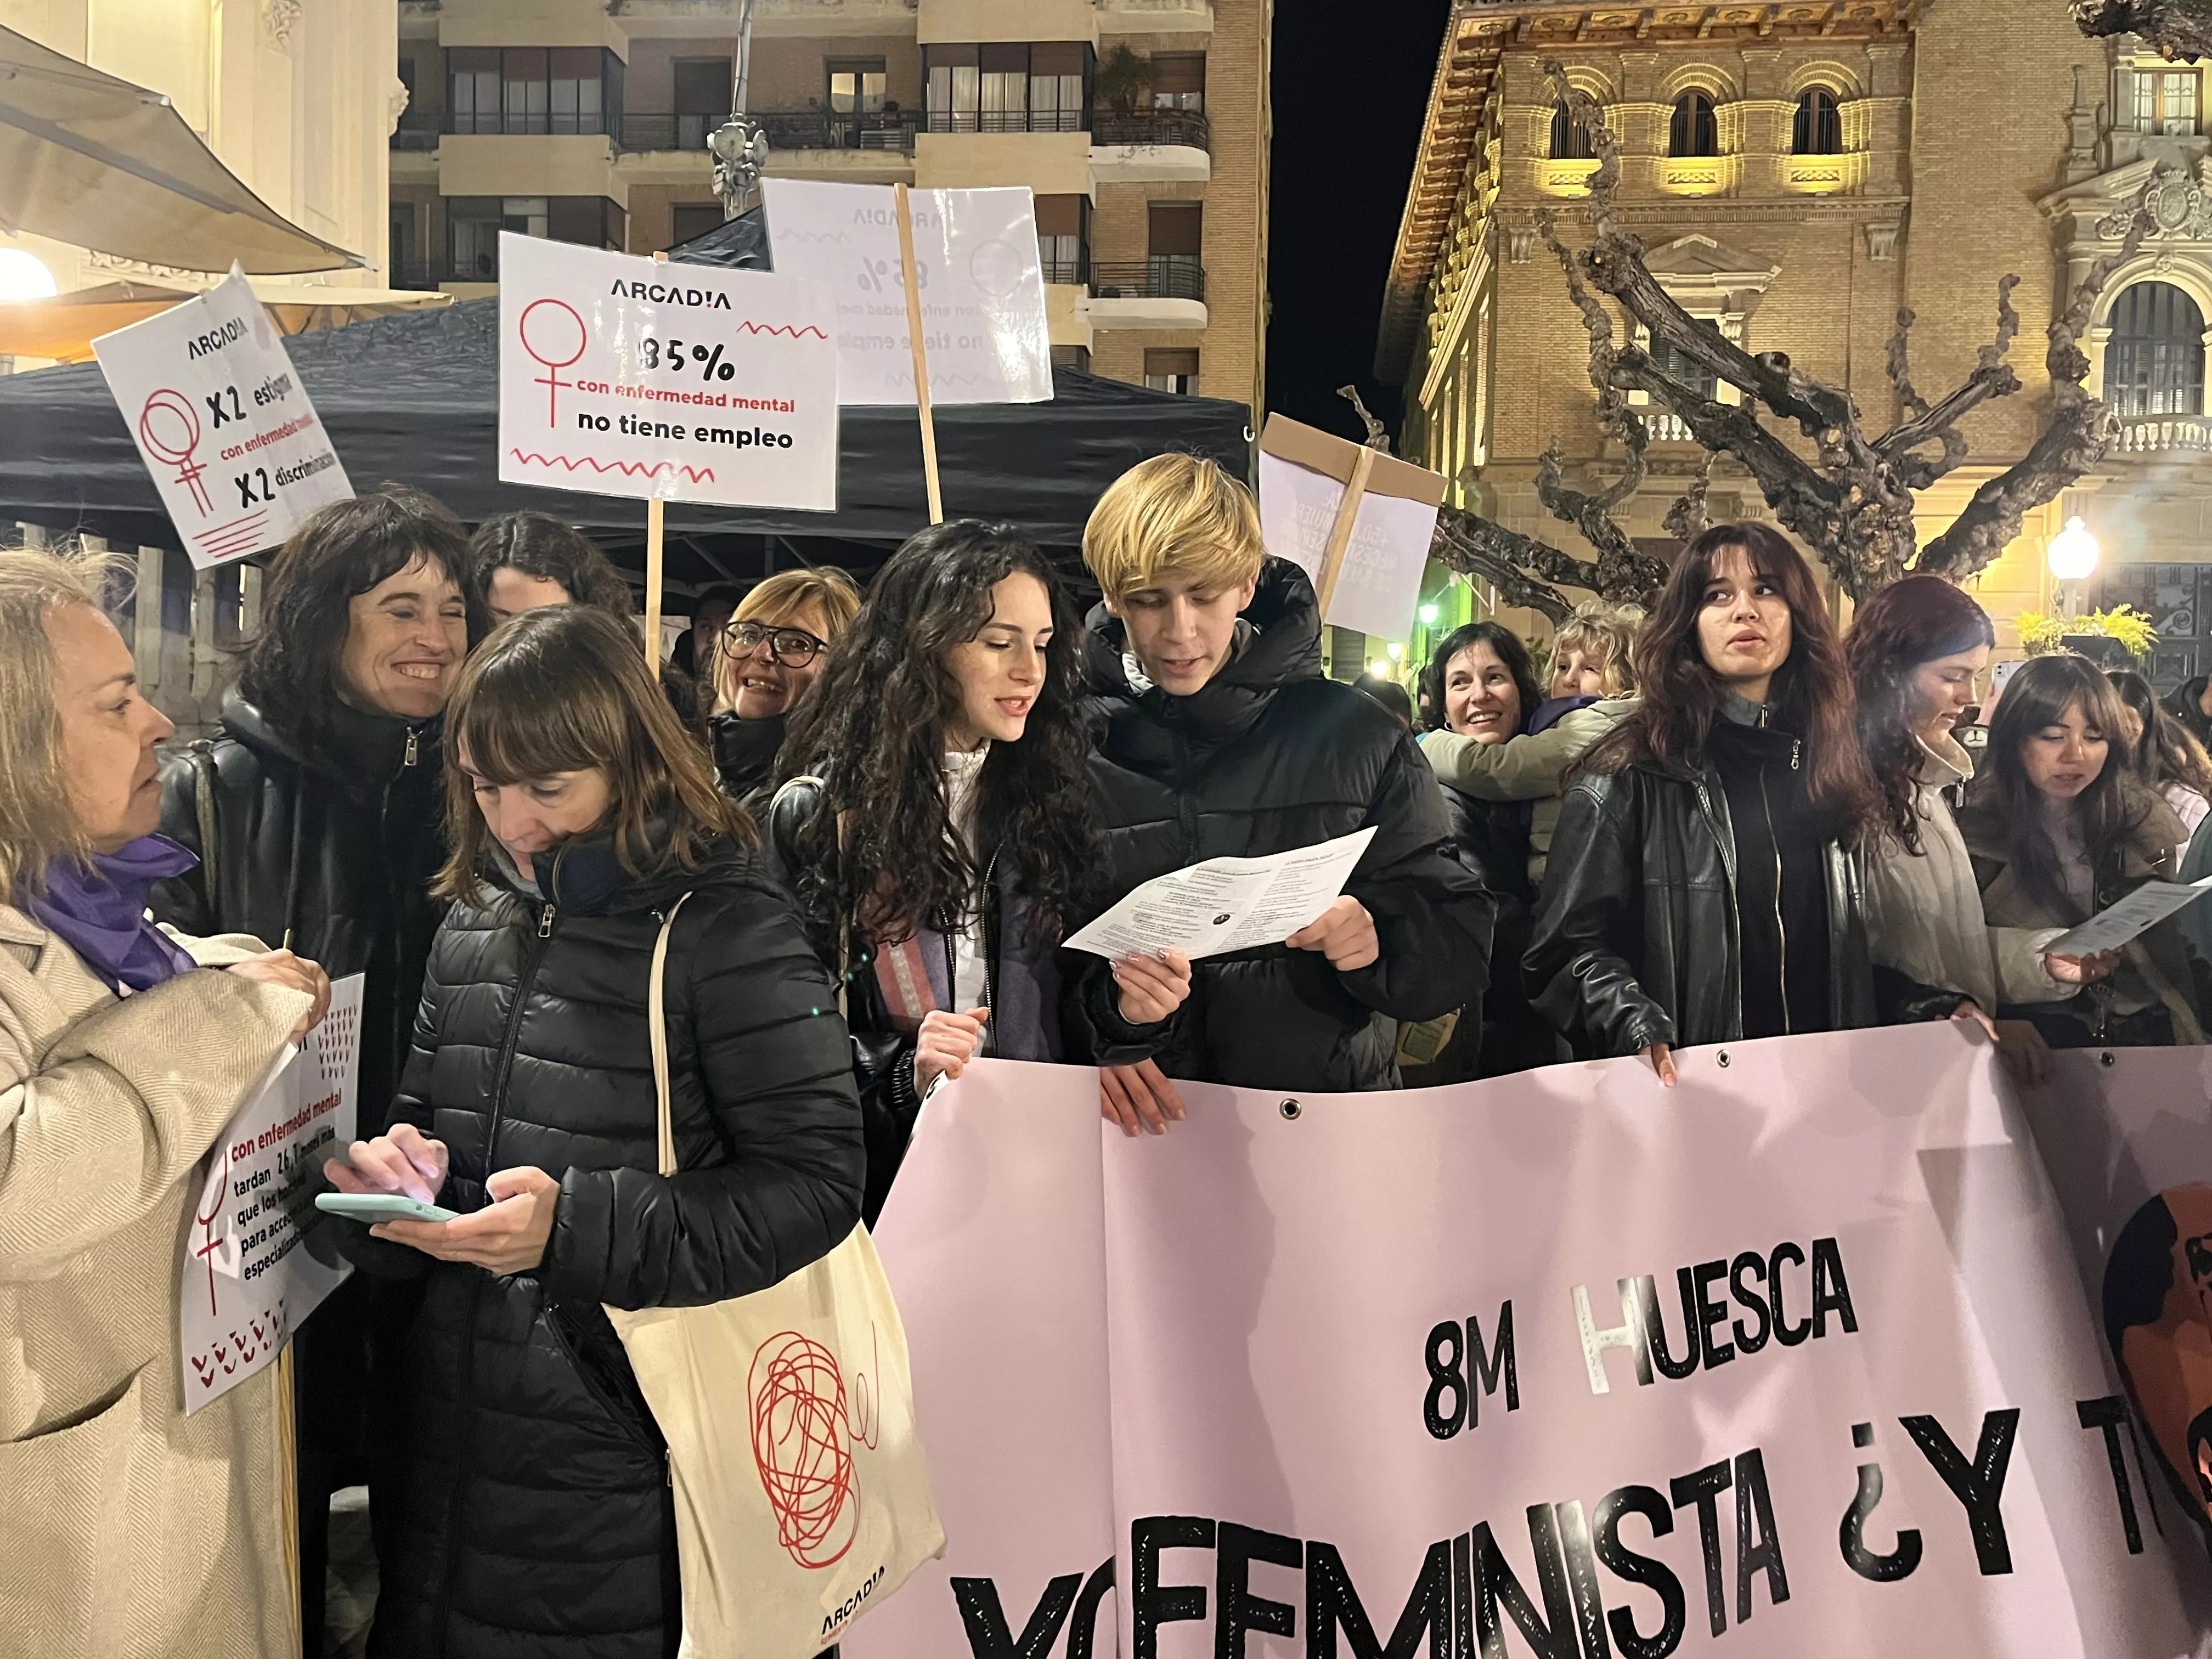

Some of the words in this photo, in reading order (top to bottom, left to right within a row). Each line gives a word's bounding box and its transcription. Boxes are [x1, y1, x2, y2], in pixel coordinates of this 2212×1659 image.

[640, 337, 735, 381] 85%
[577, 379, 609, 394] con
[615, 384, 727, 408] enfermedad
[732, 397, 795, 413] mental
[578, 413, 610, 432] no
[619, 414, 686, 440] tiene
[695, 425, 793, 449] empleo
[221, 443, 244, 461] con
[232, 1138, 255, 1163] con
[258, 1103, 311, 1149] enfermedad
[313, 1087, 342, 1118] mental
[234, 1169, 271, 1197] tardan
[238, 1204, 259, 1227] que
[262, 1193, 276, 1212] los
[241, 1228, 267, 1257] para
[1423, 1299, 1519, 1440] 8M
[1570, 1237, 1859, 1395] HUESCA
[1132, 1447, 1790, 1659] FEMINISTA
[1839, 1408, 2021, 1582] ¿Y
[2076, 1395, 2162, 1555] T
